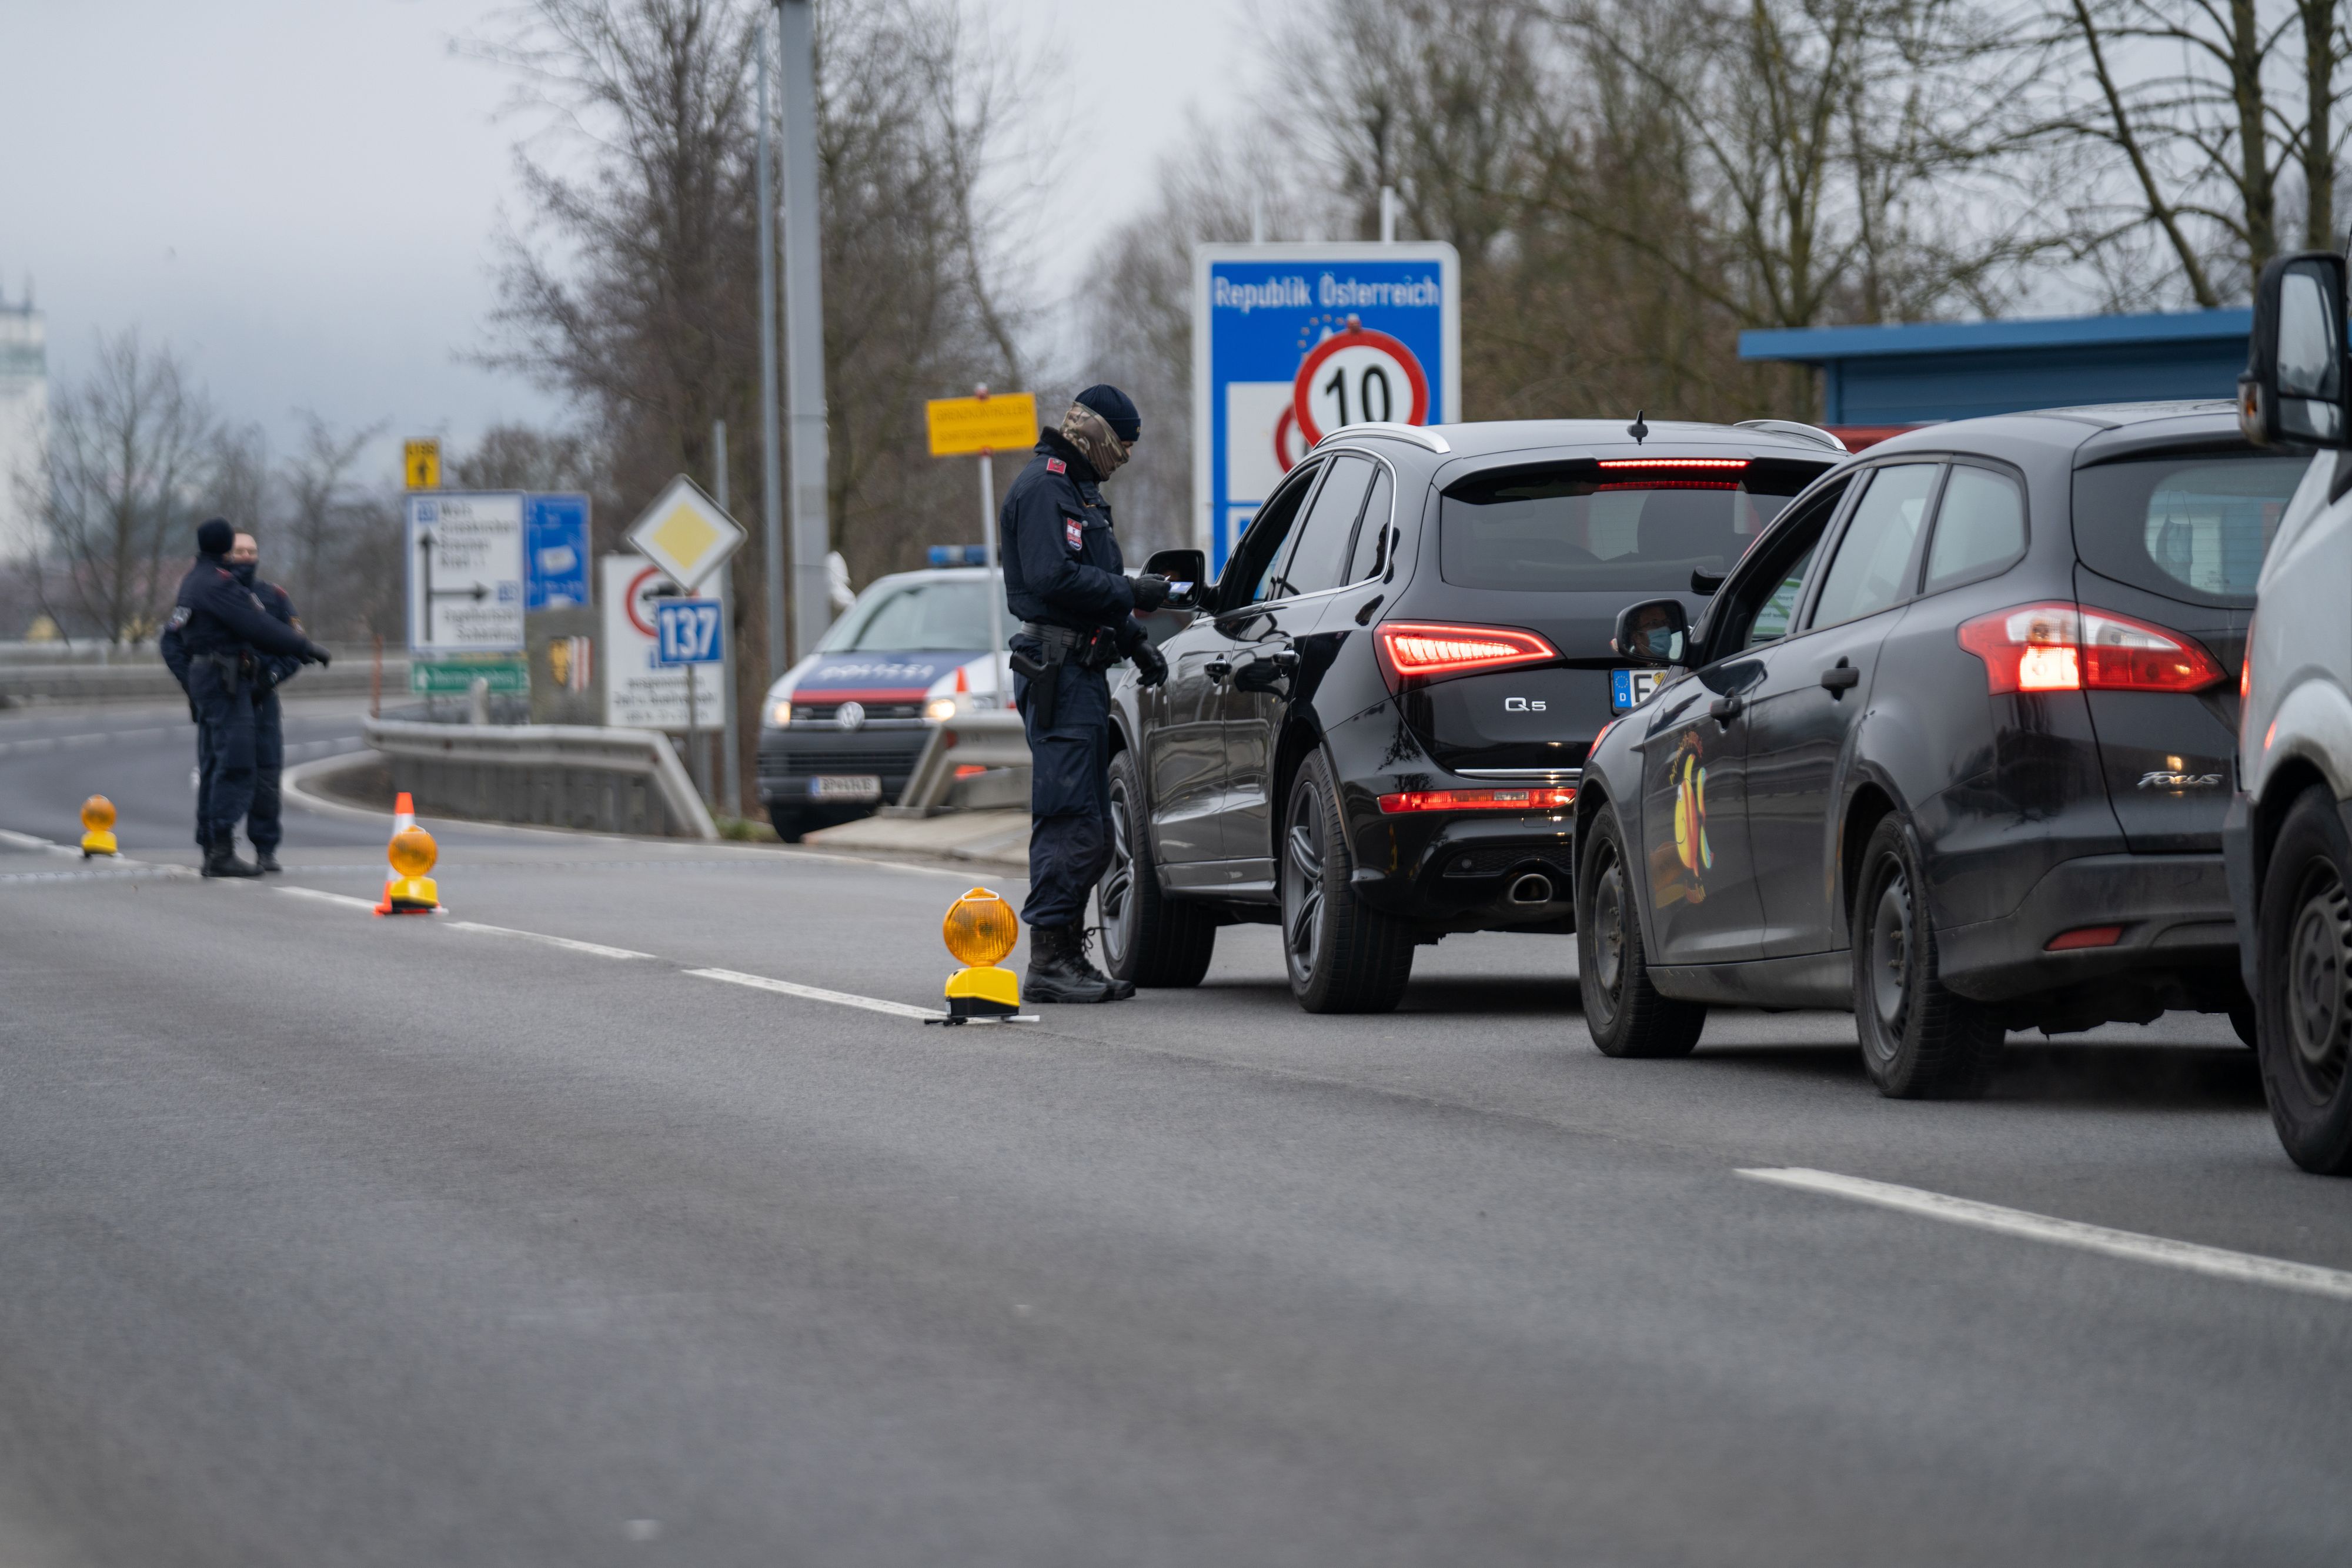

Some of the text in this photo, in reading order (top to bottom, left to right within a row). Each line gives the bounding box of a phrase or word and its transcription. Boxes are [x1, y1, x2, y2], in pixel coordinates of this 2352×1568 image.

[1214, 271, 1439, 313] Republik Österreich
[1326, 365, 1391, 427] 10
[662, 607, 718, 658] 137
[1505, 697, 1546, 711] Q5
[1619, 693, 1626, 701] D
[1633, 674, 1652, 703] F
